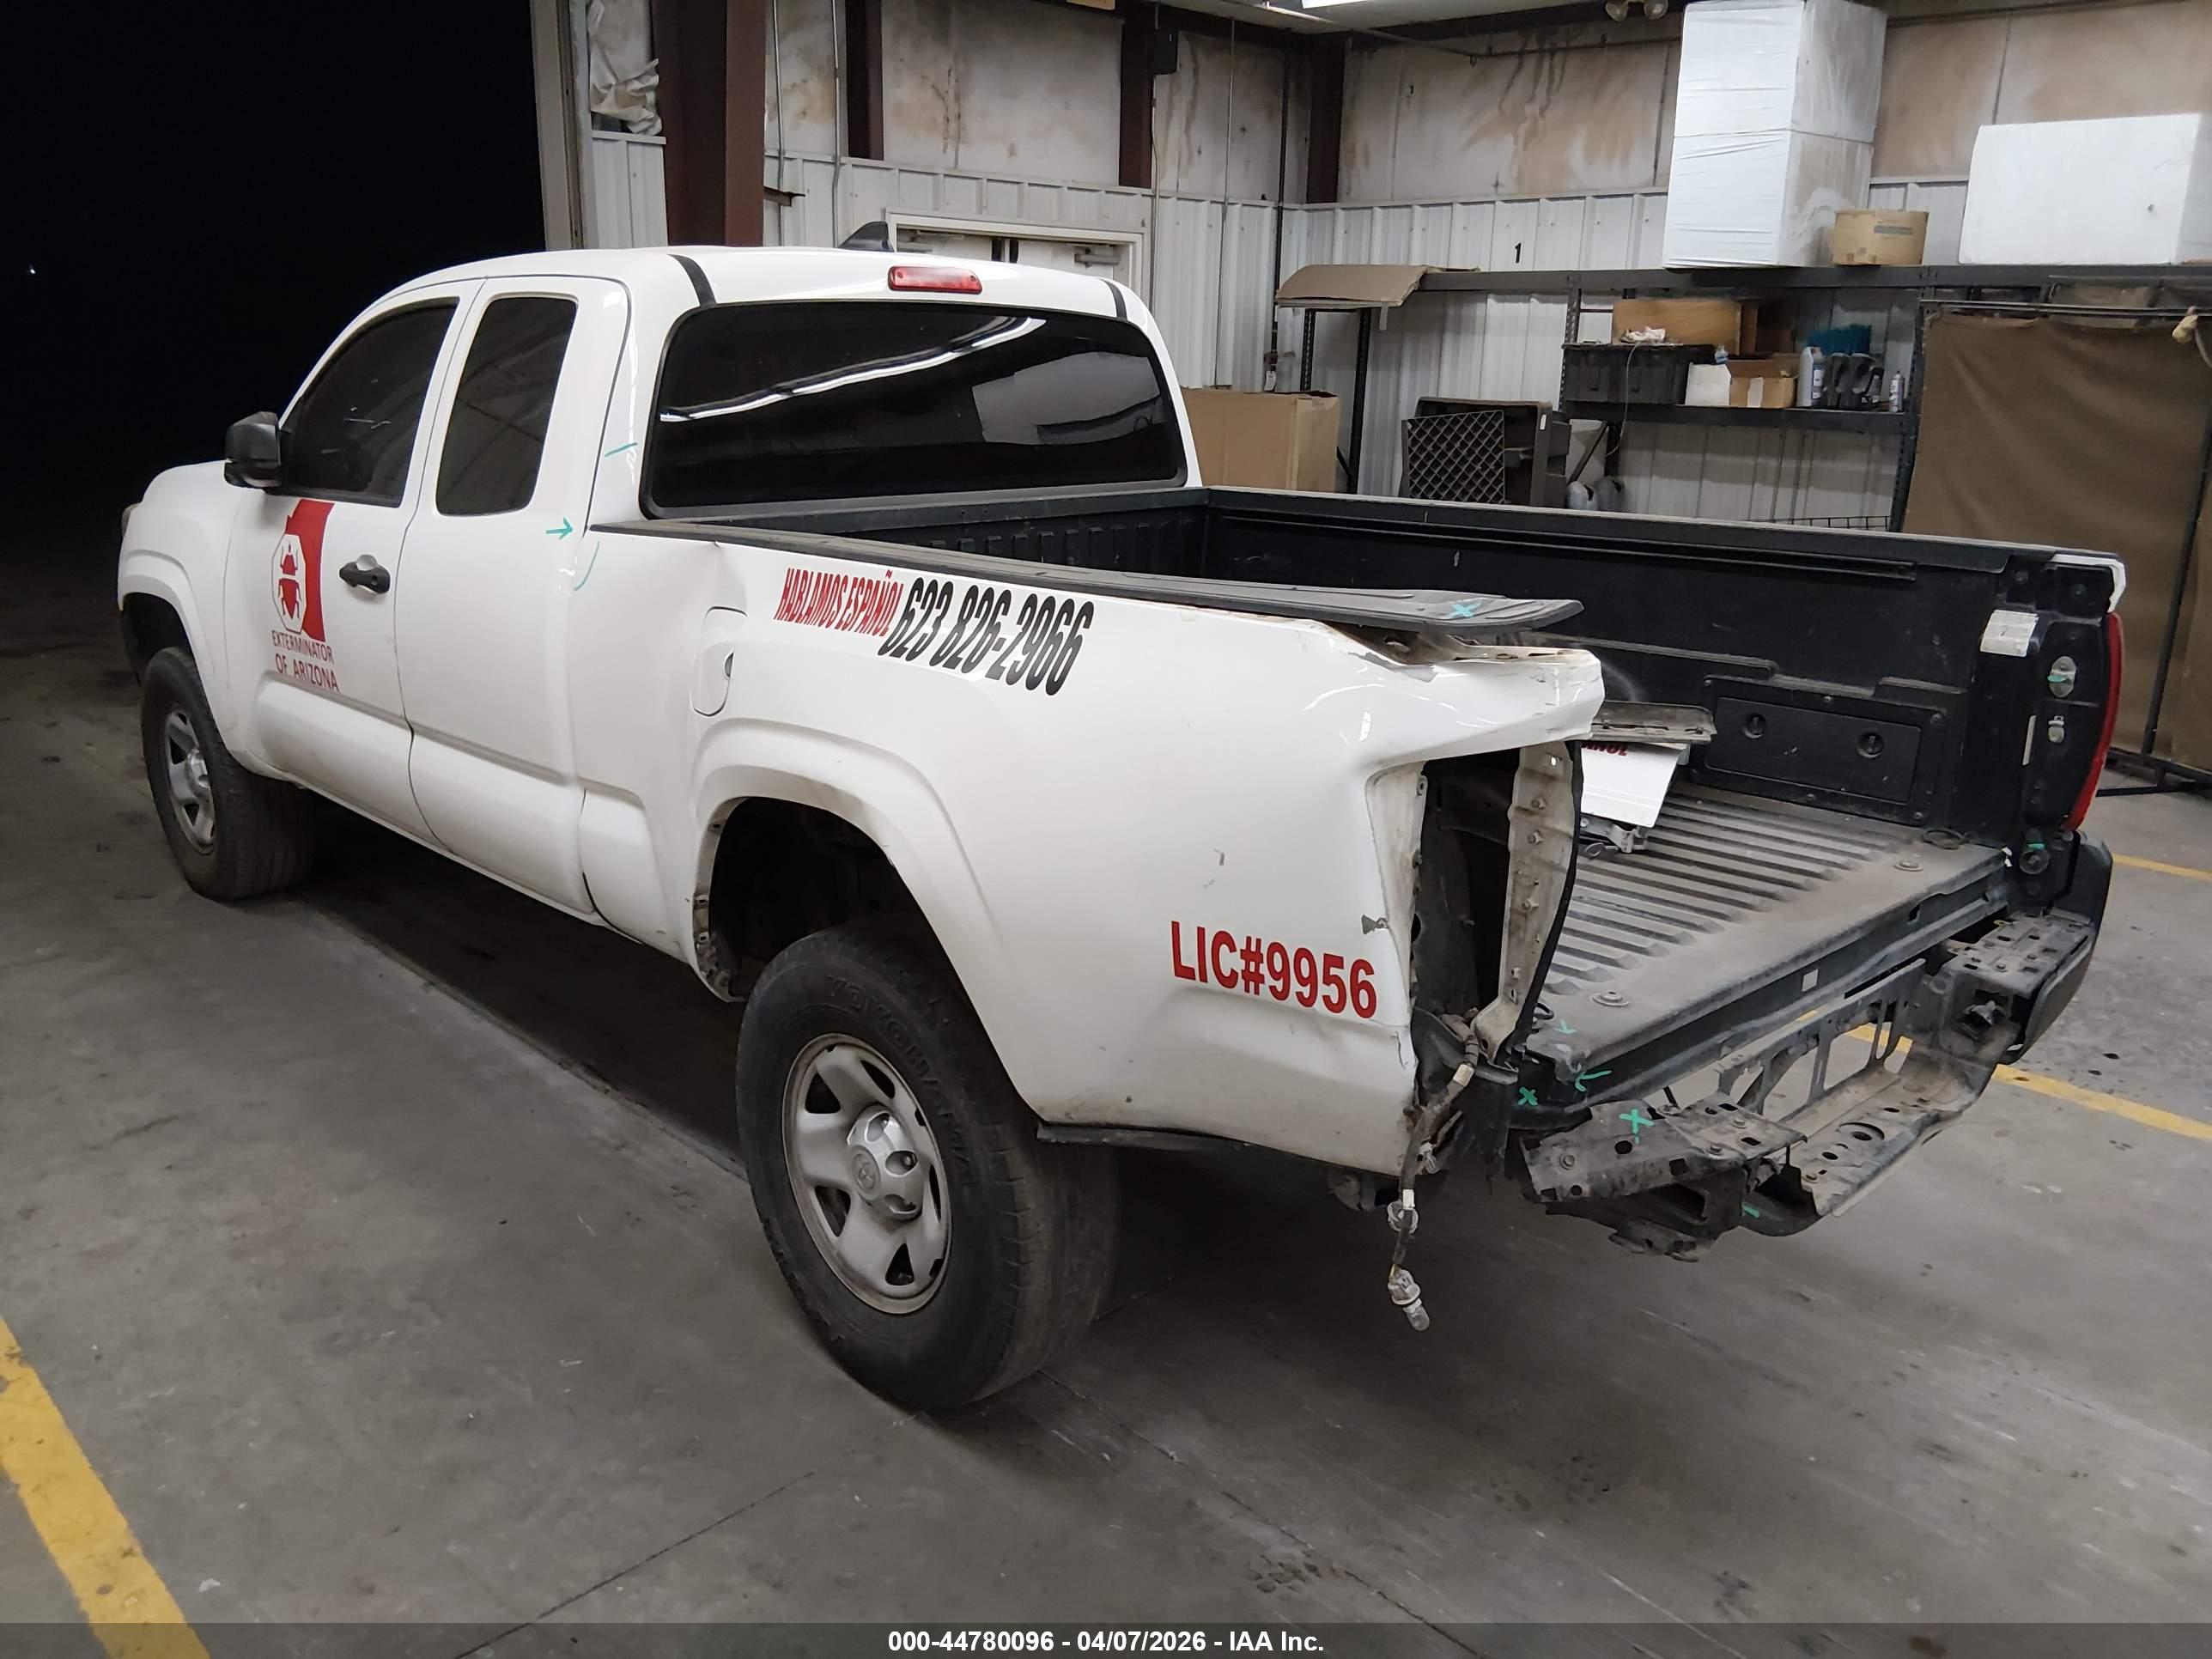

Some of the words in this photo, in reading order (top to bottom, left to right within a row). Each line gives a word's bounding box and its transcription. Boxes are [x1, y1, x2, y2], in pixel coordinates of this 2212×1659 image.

[1514, 242, 1522, 264] 1
[773, 567, 848, 629] HABLAMOS
[834, 568, 904, 637] ESPAÑOL
[271, 629, 334, 665] EXTERMINATOR
[877, 576, 954, 662] 623
[928, 584, 1095, 696] 826-2966
[275, 653, 288, 677] OF
[293, 659, 340, 693] ARIZONA
[1170, 920, 1378, 1019] LIC#9956
